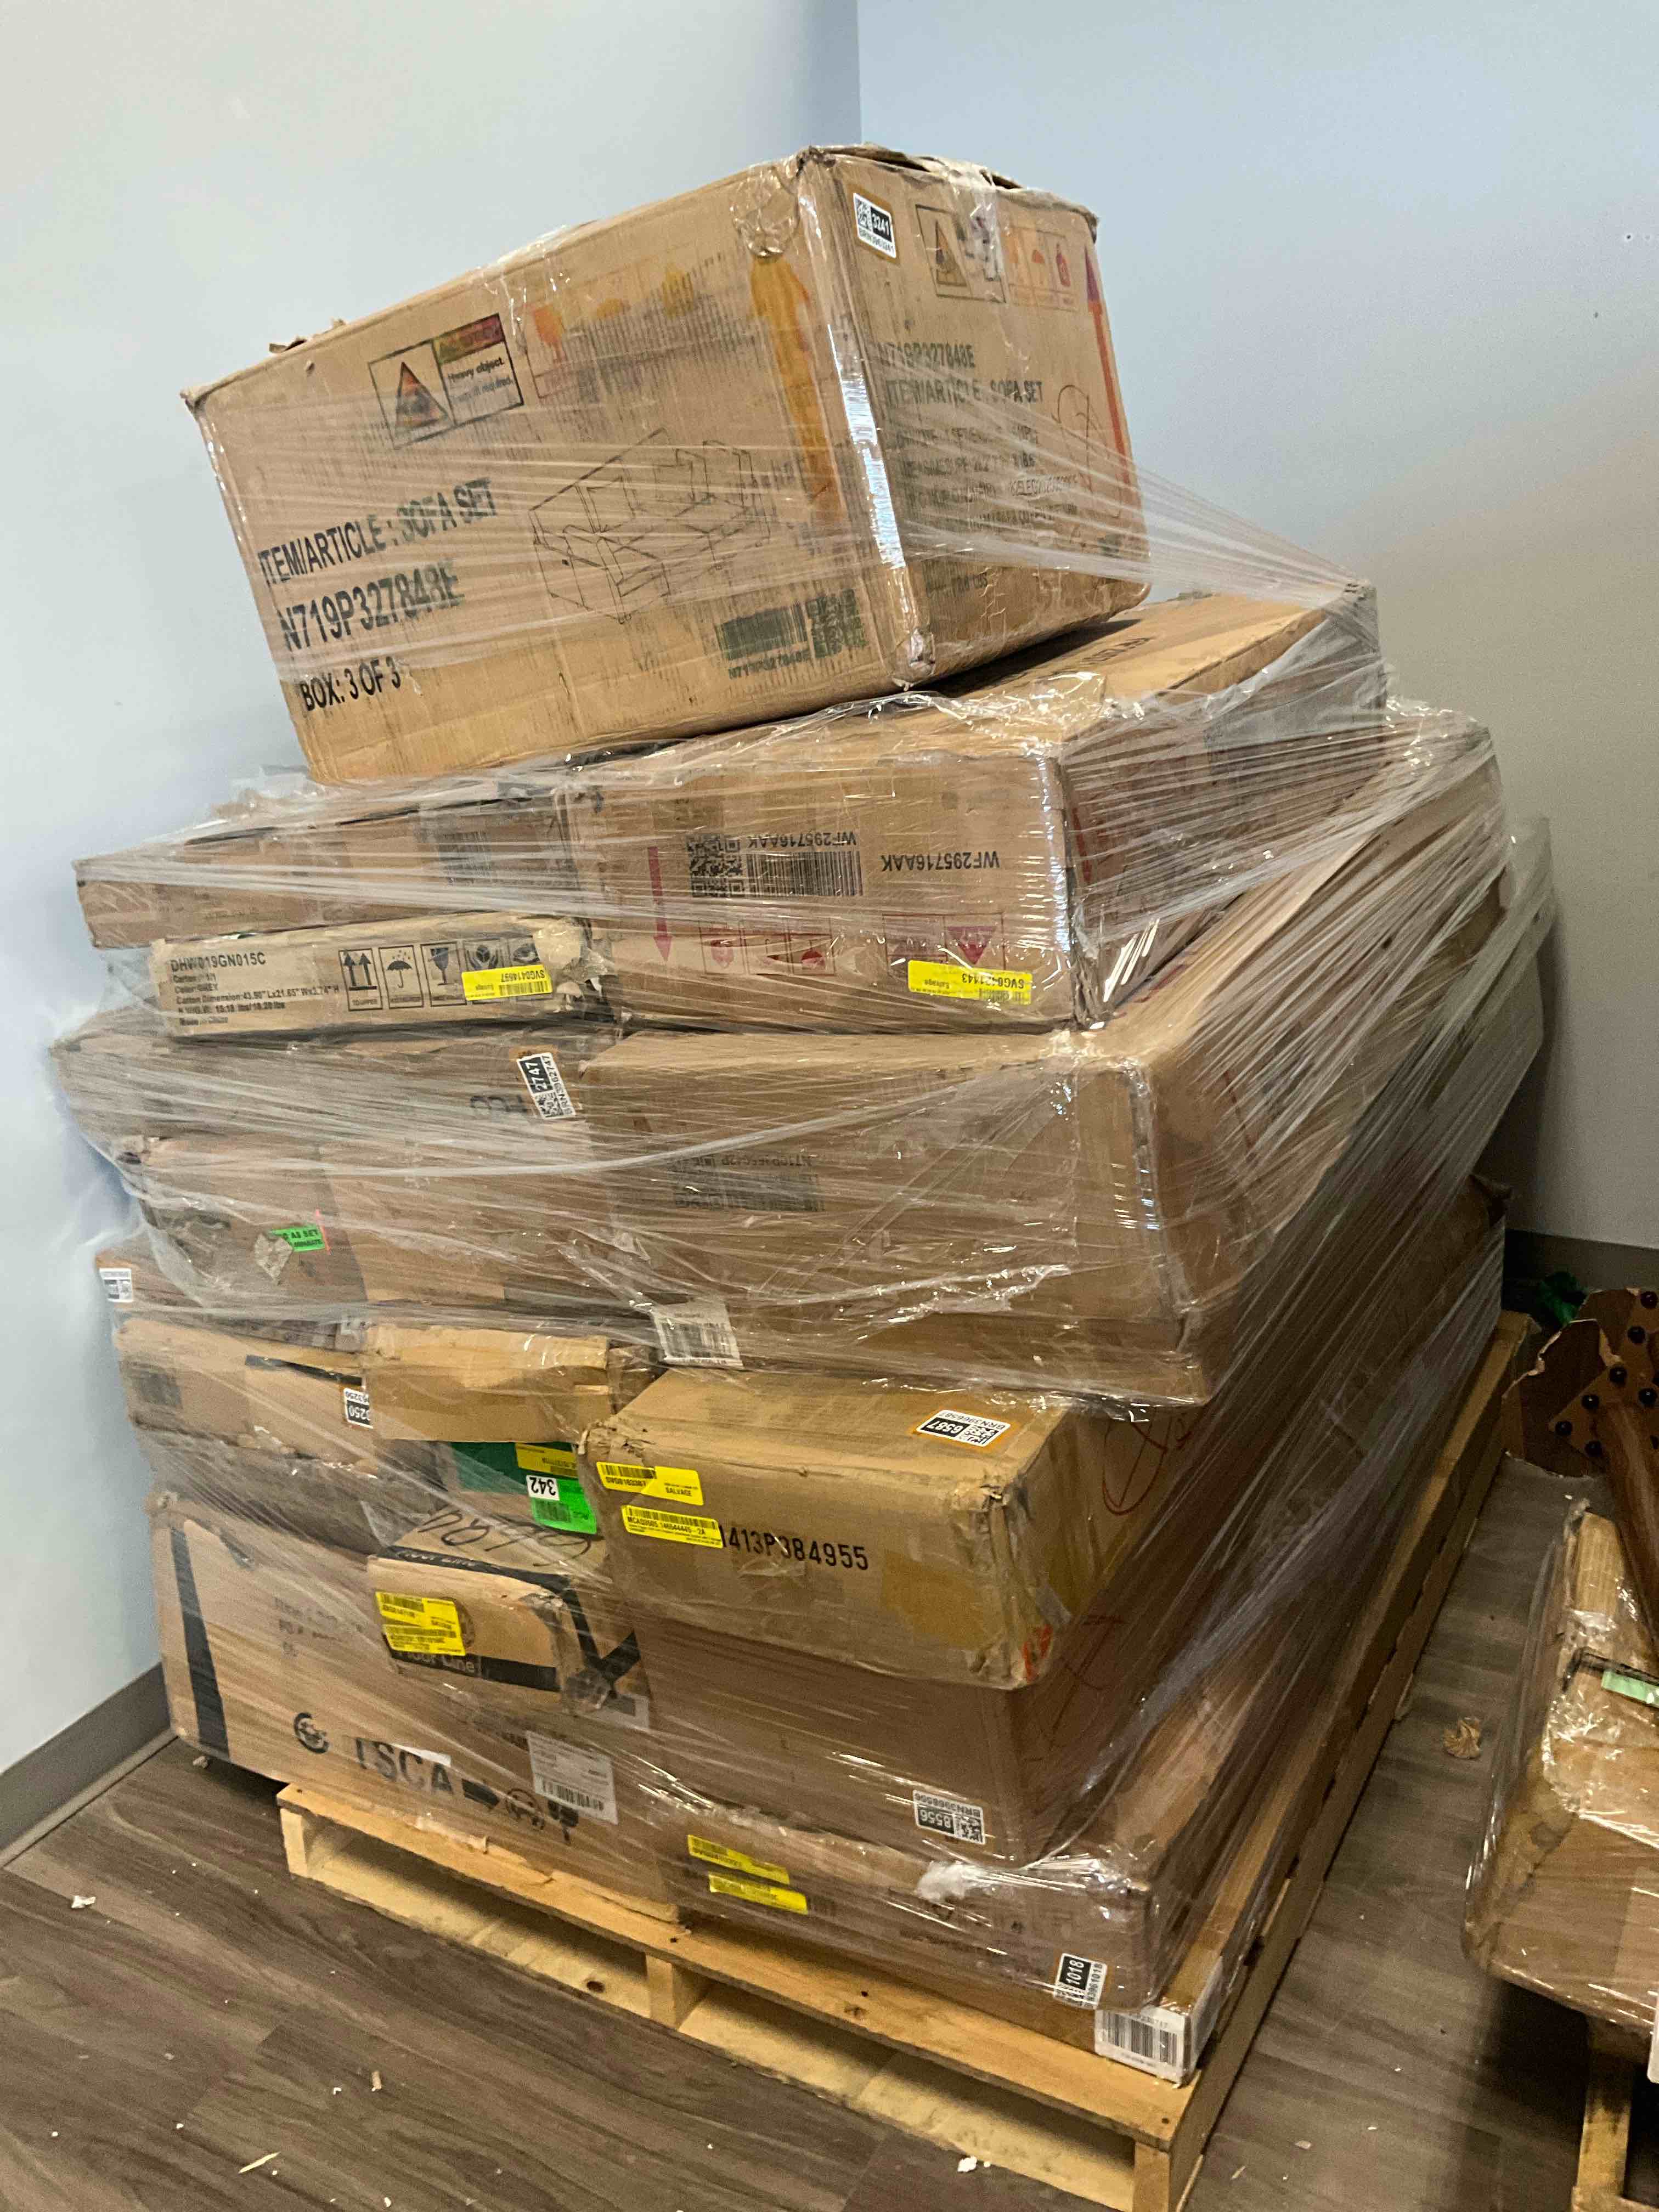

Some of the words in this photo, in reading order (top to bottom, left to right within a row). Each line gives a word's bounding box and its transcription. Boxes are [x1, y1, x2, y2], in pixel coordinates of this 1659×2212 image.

[872, 212, 890, 236] 3241
[396, 492, 458, 541] SOFA
[453, 477, 498, 524] SET
[299, 673, 346, 711] BOX:
[343, 668, 360, 699] 3
[358, 658, 385, 696] OF
[385, 656, 402, 689] 3
[748, 832, 857, 849] WF295716AAK
[880, 851, 1001, 872] WF295716AAK
[524, 1062, 548, 1092] 2747
[926, 1420, 964, 1435] 6587
[529, 1476, 556, 1497] 342
[919, 1809, 952, 1829] 8556
[1066, 1960, 1085, 1985] 1018
